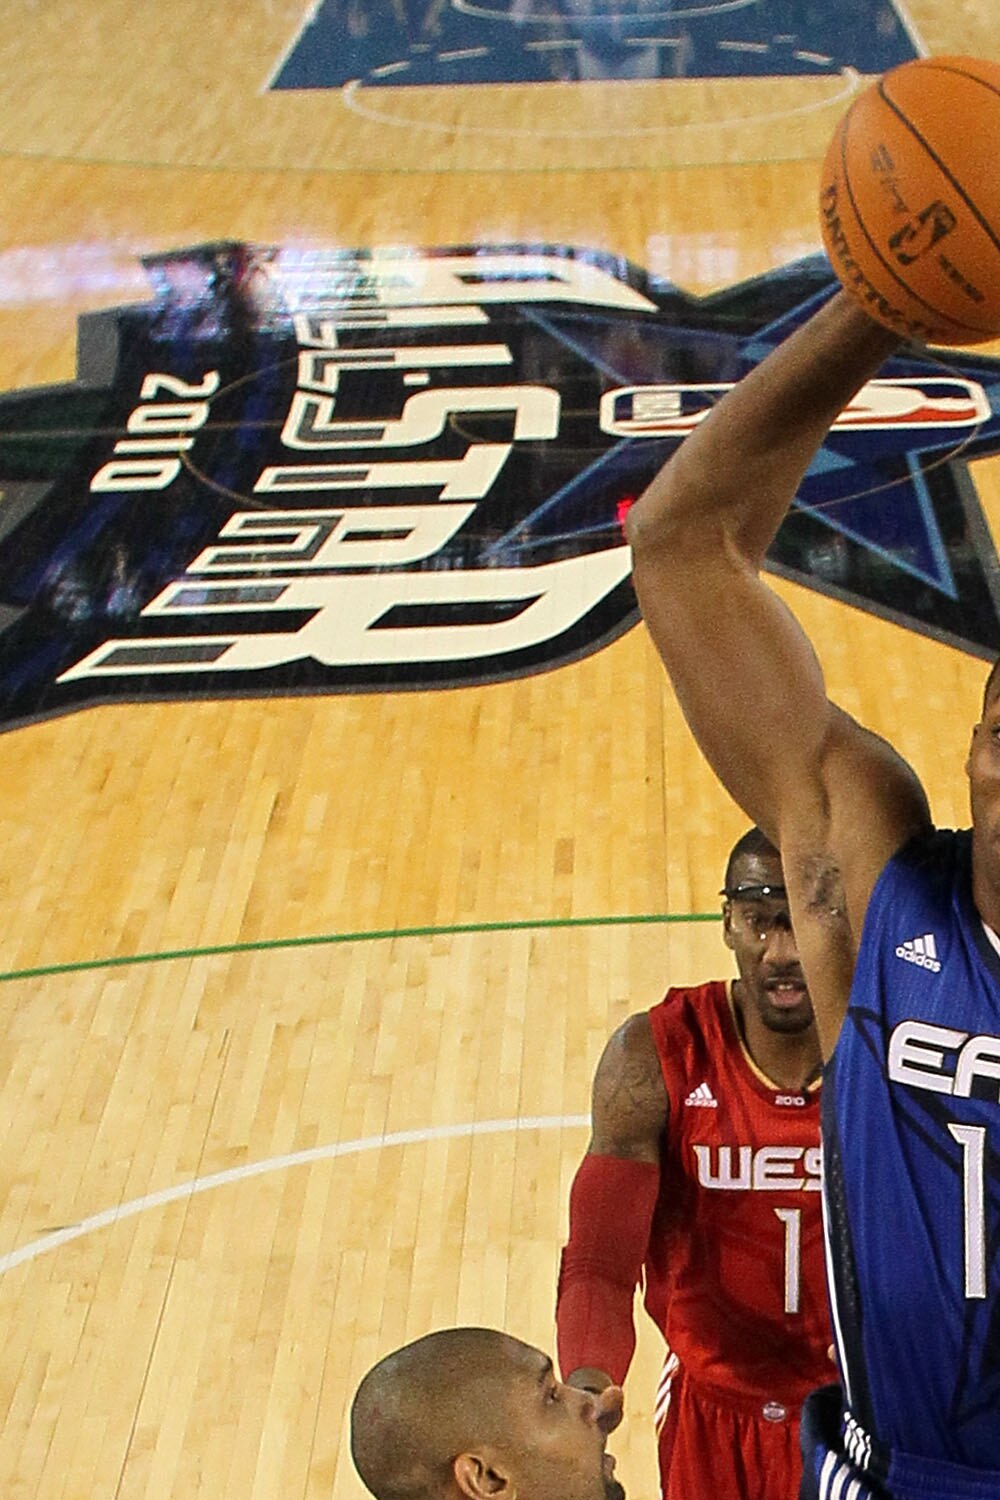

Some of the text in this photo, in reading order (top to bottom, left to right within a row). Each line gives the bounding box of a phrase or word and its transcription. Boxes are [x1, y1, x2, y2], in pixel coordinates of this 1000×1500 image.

[89, 369, 220, 492] 2010
[895, 946, 942, 973] adidas
[773, 1208, 801, 1314] 1
